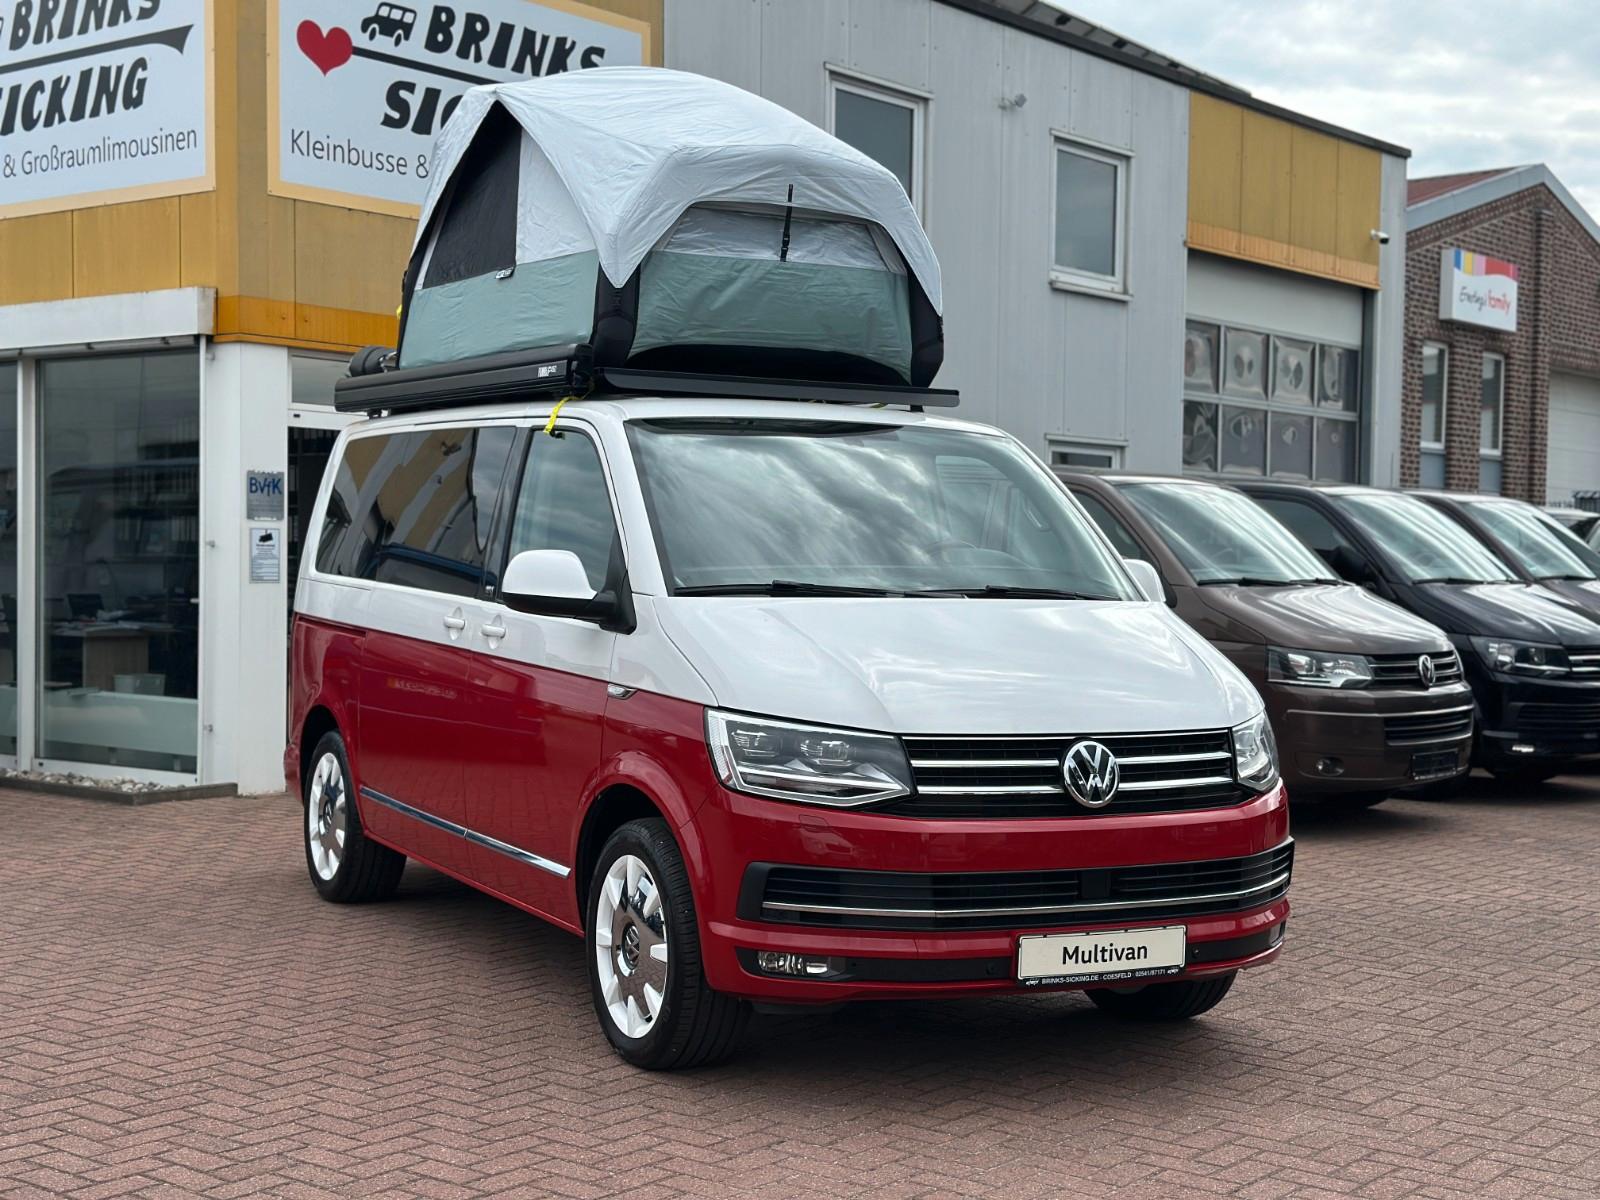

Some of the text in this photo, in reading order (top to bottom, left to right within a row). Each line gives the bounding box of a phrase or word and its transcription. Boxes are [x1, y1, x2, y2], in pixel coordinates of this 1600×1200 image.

[0, 57, 148, 136] ICKING
[3, 128, 197, 178] & Großraumlimousinen
[291, 129, 429, 178] Kleinbusse &
[249, 477, 282, 497] BVfK
[1062, 943, 1148, 965] Multivan
